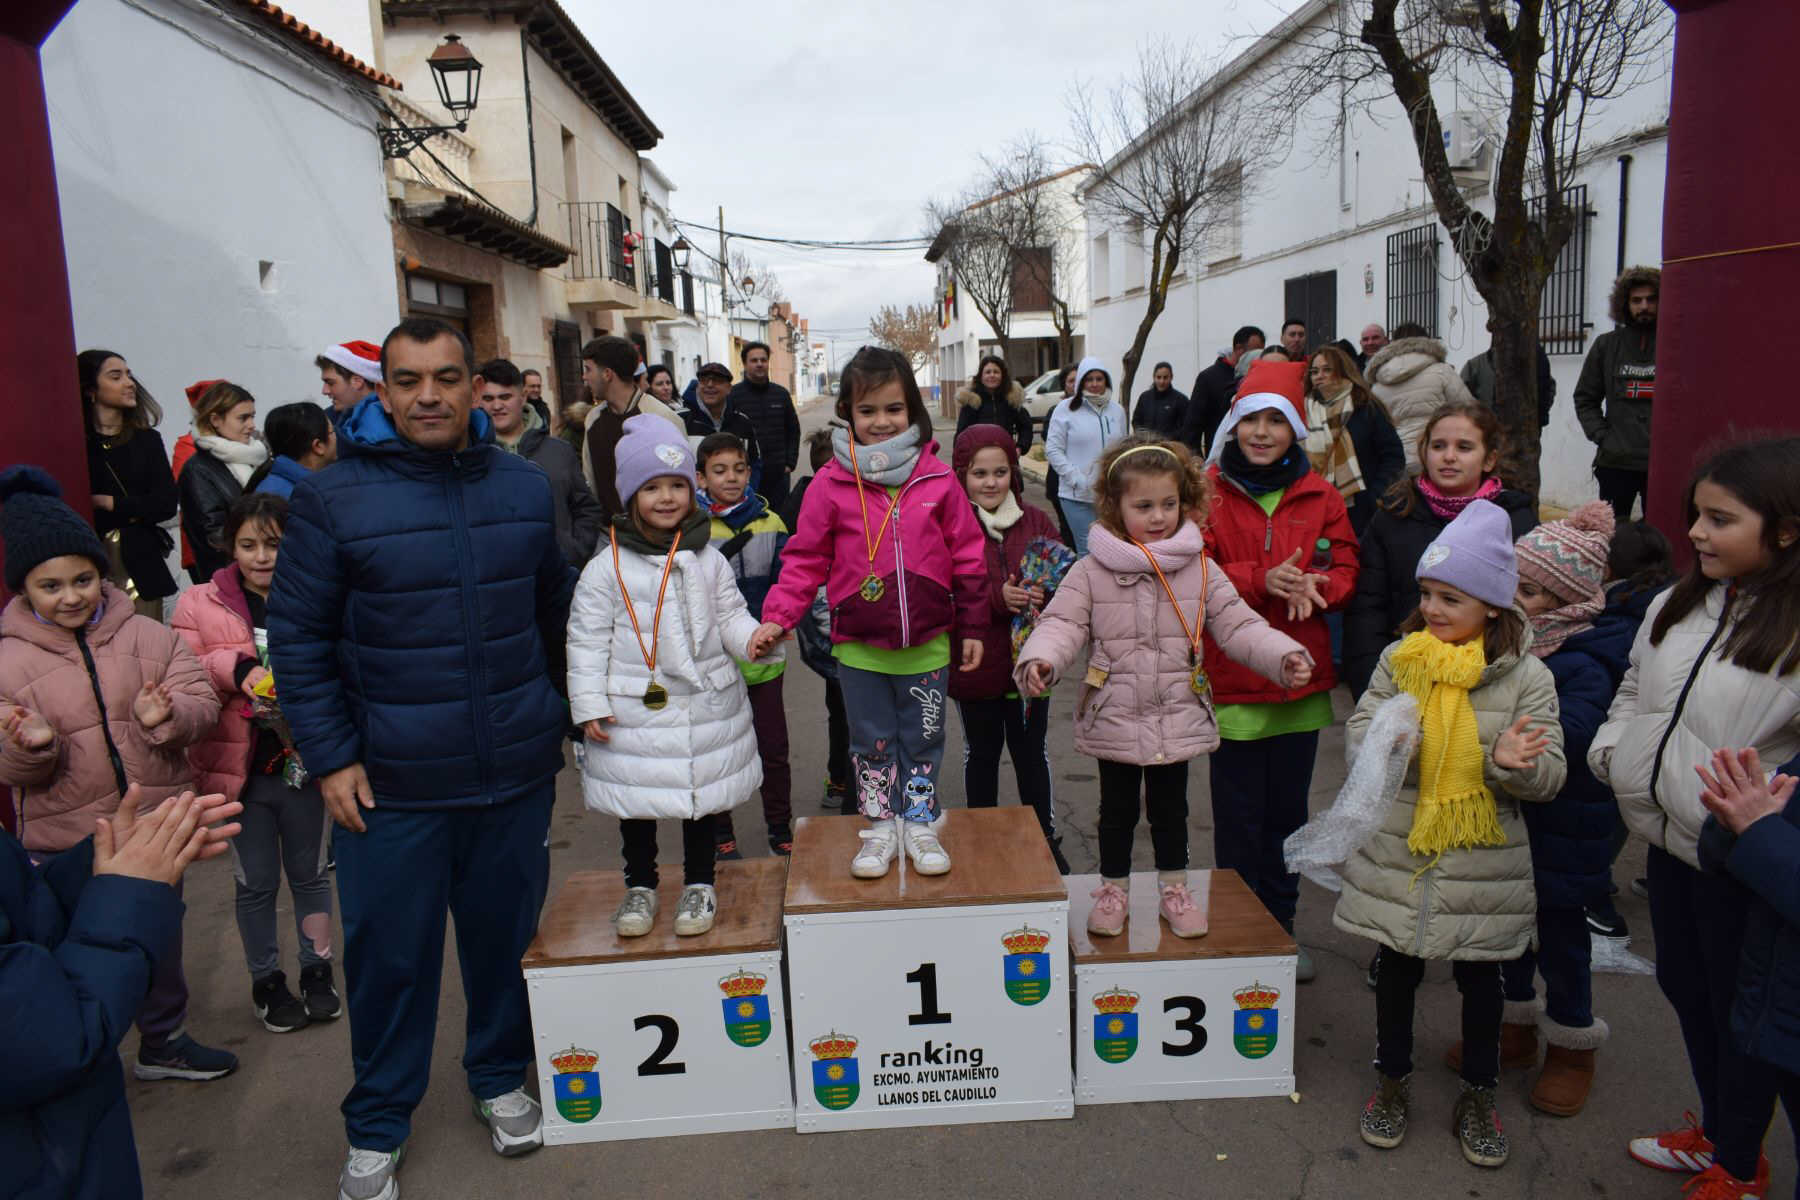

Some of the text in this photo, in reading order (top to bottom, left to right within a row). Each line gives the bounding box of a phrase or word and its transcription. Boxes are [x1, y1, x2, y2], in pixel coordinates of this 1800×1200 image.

[909, 686, 942, 741] Stitch
[907, 963, 952, 1026] 1
[633, 1014, 687, 1077] 2
[1161, 995, 1208, 1057] 3
[873, 1066, 999, 1086] EXCMO. AYUNTAMIENTO
[880, 1040, 984, 1068] ranking
[878, 1086, 997, 1105] LLANOS DEL CAUDILLO
